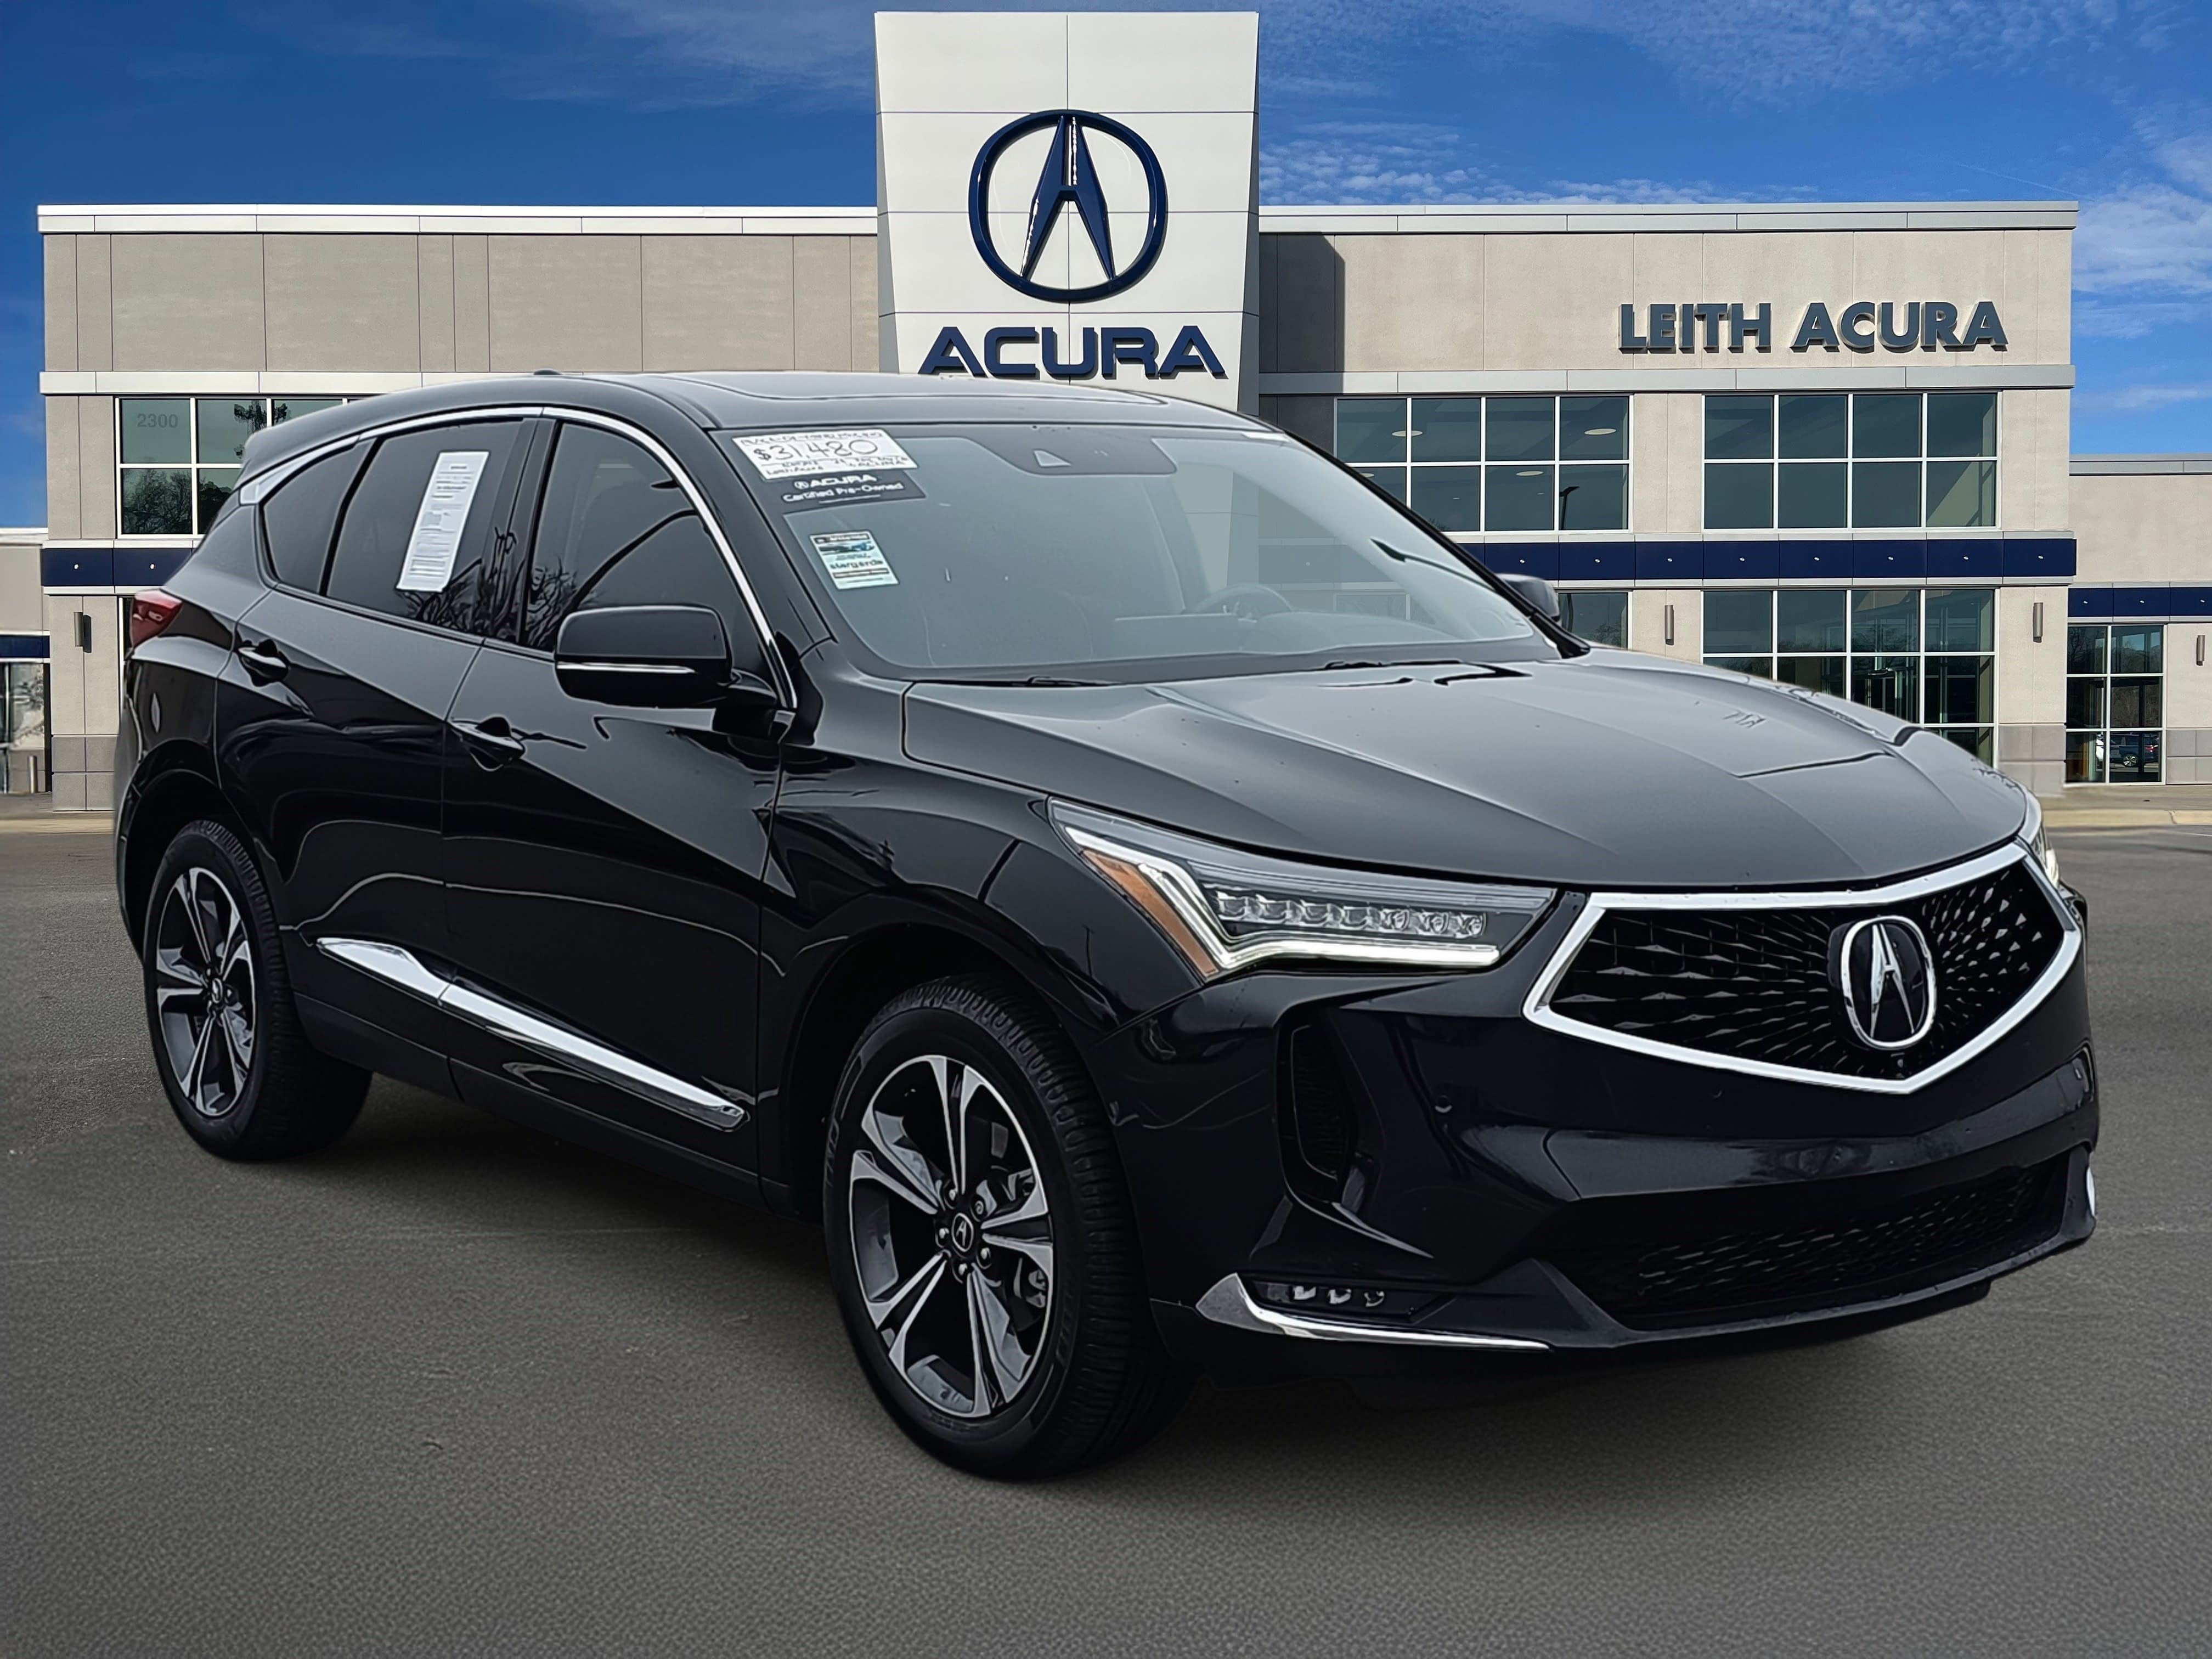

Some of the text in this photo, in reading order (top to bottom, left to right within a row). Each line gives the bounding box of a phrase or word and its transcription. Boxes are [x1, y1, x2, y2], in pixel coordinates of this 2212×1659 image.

[1619, 301, 2008, 353] LEITH ACURA
[918, 325, 1227, 379] ACURA
[137, 413, 178, 428] 2300
[753, 439, 878, 461] $31,480
[810, 475, 877, 487] ACURA
[783, 483, 904, 501] Certified Pre-Owned
